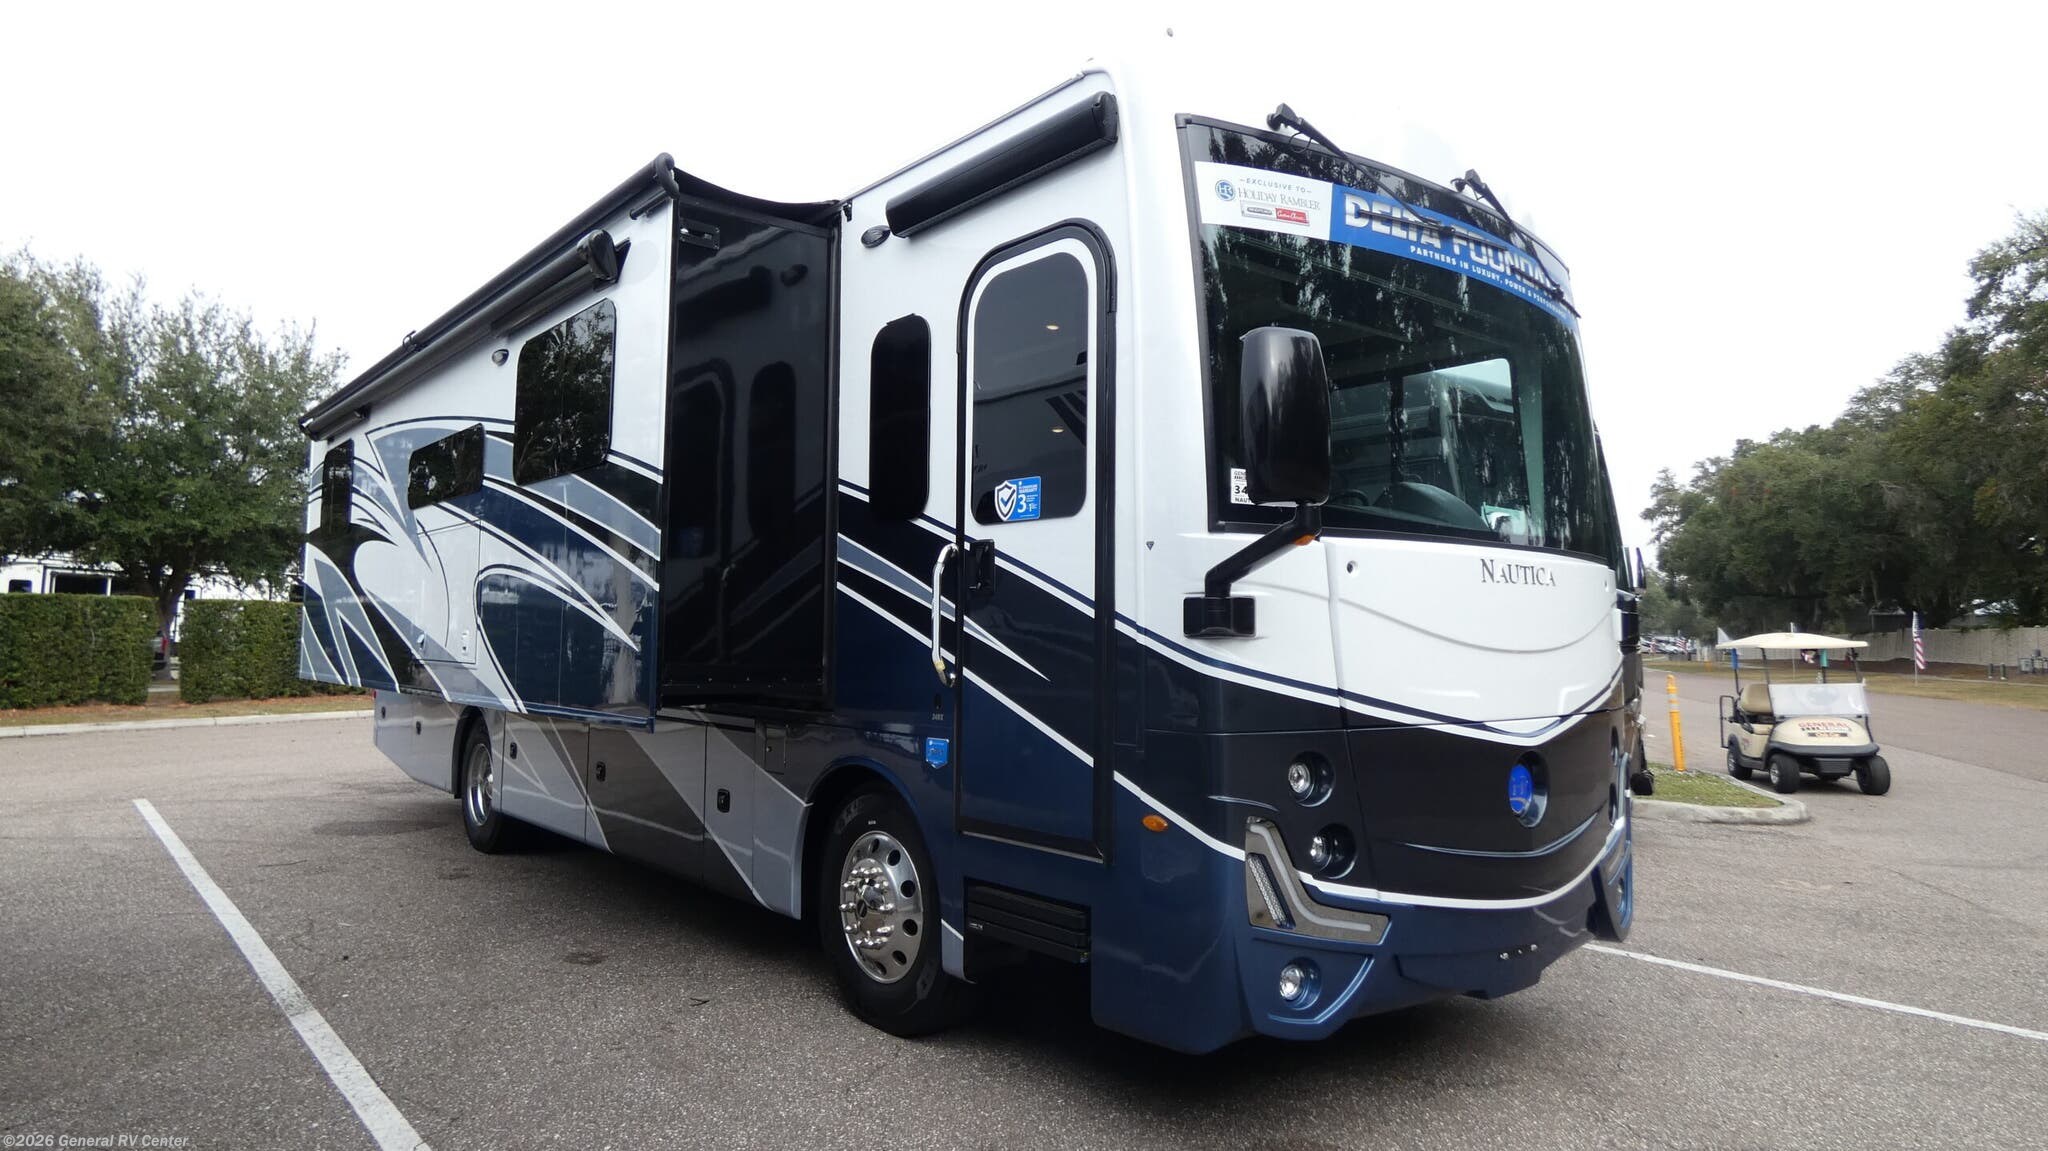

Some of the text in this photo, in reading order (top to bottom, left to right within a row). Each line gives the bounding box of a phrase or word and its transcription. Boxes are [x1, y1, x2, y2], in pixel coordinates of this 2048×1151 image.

[1246, 178, 1292, 190] EXCLUSIVE
[1238, 187, 1321, 210] HOLIDAY RAMBLER
[1345, 193, 1441, 249] DELTA
[1410, 245, 1457, 266] PARTNERS
[1460, 260, 1469, 270] IN
[1504, 278, 1526, 294] POWER
[1017, 493, 1027, 513] 3
[1480, 558, 1556, 587] NAUTICA
